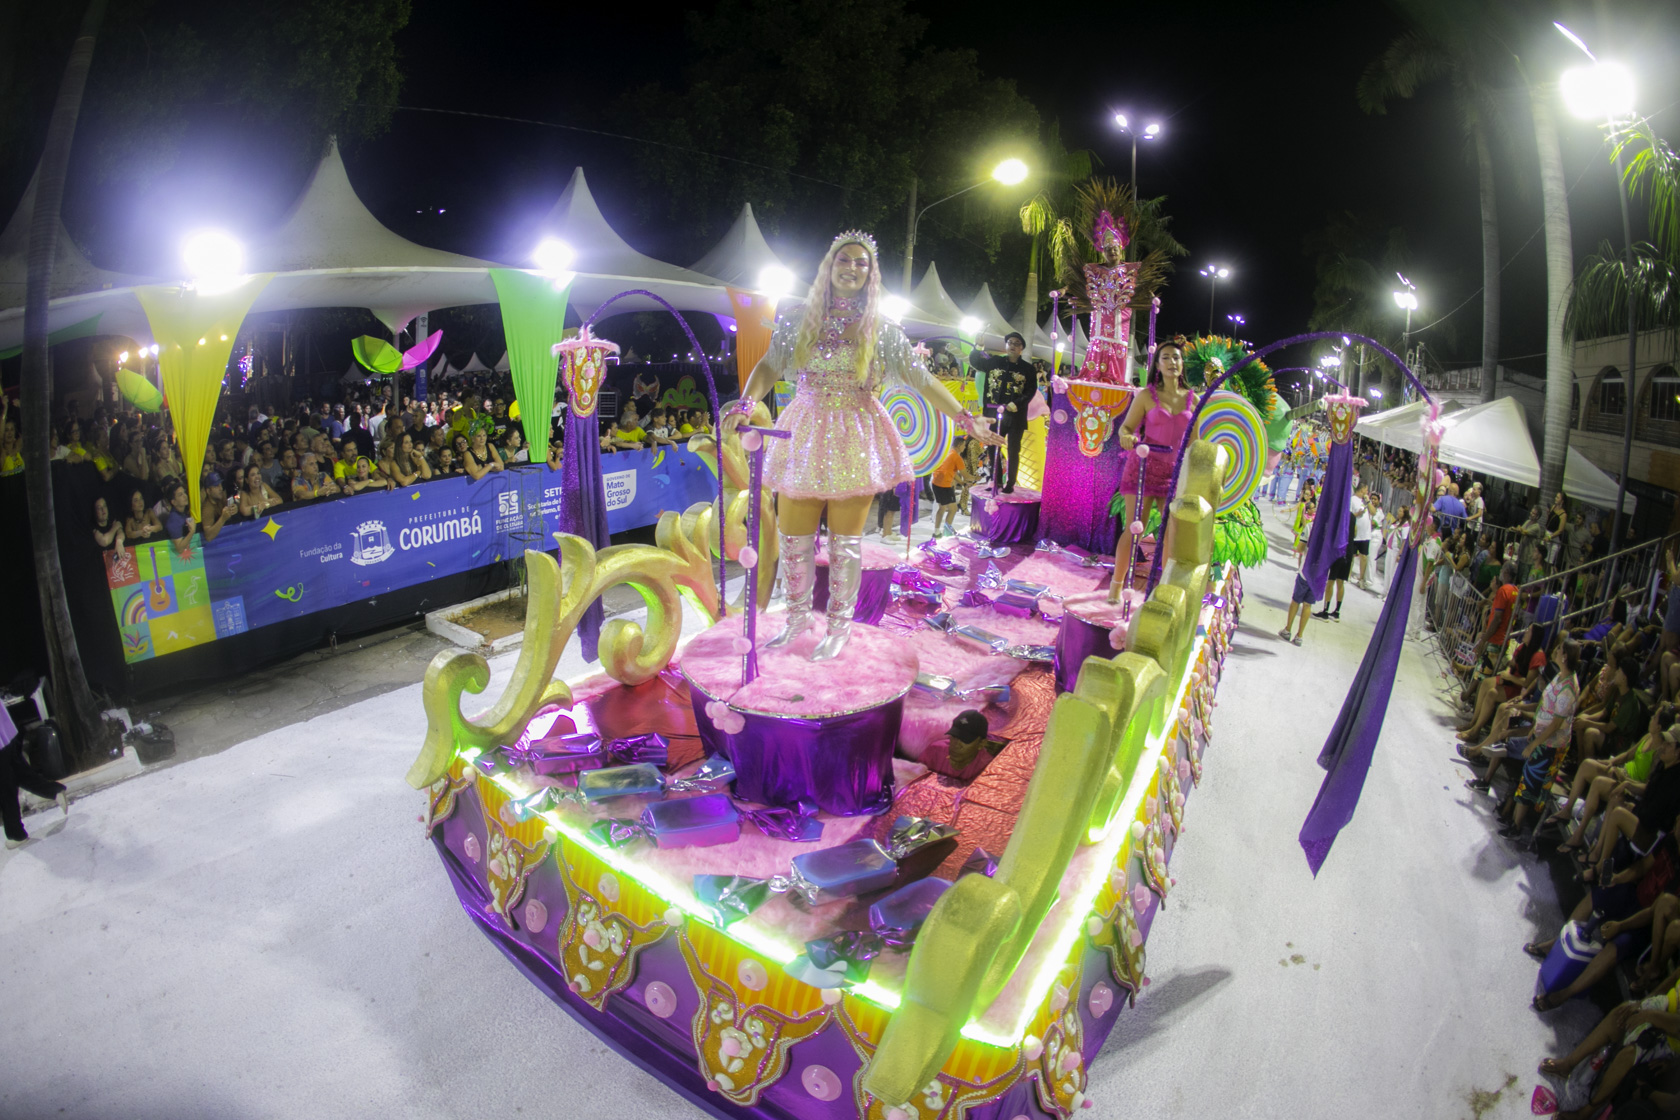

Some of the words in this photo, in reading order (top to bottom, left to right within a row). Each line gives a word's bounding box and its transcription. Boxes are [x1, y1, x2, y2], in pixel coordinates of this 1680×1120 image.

[606, 481, 625, 490] Mato
[606, 488, 631, 498] Grosso
[606, 499, 616, 507] do
[617, 495, 627, 505] Sul
[408, 508, 457, 525] PREFEITURA
[399, 509, 482, 551] CORUMBÁ
[299, 543, 333, 558] Fundação
[333, 541, 342, 550] da
[320, 552, 343, 563] Cultura
